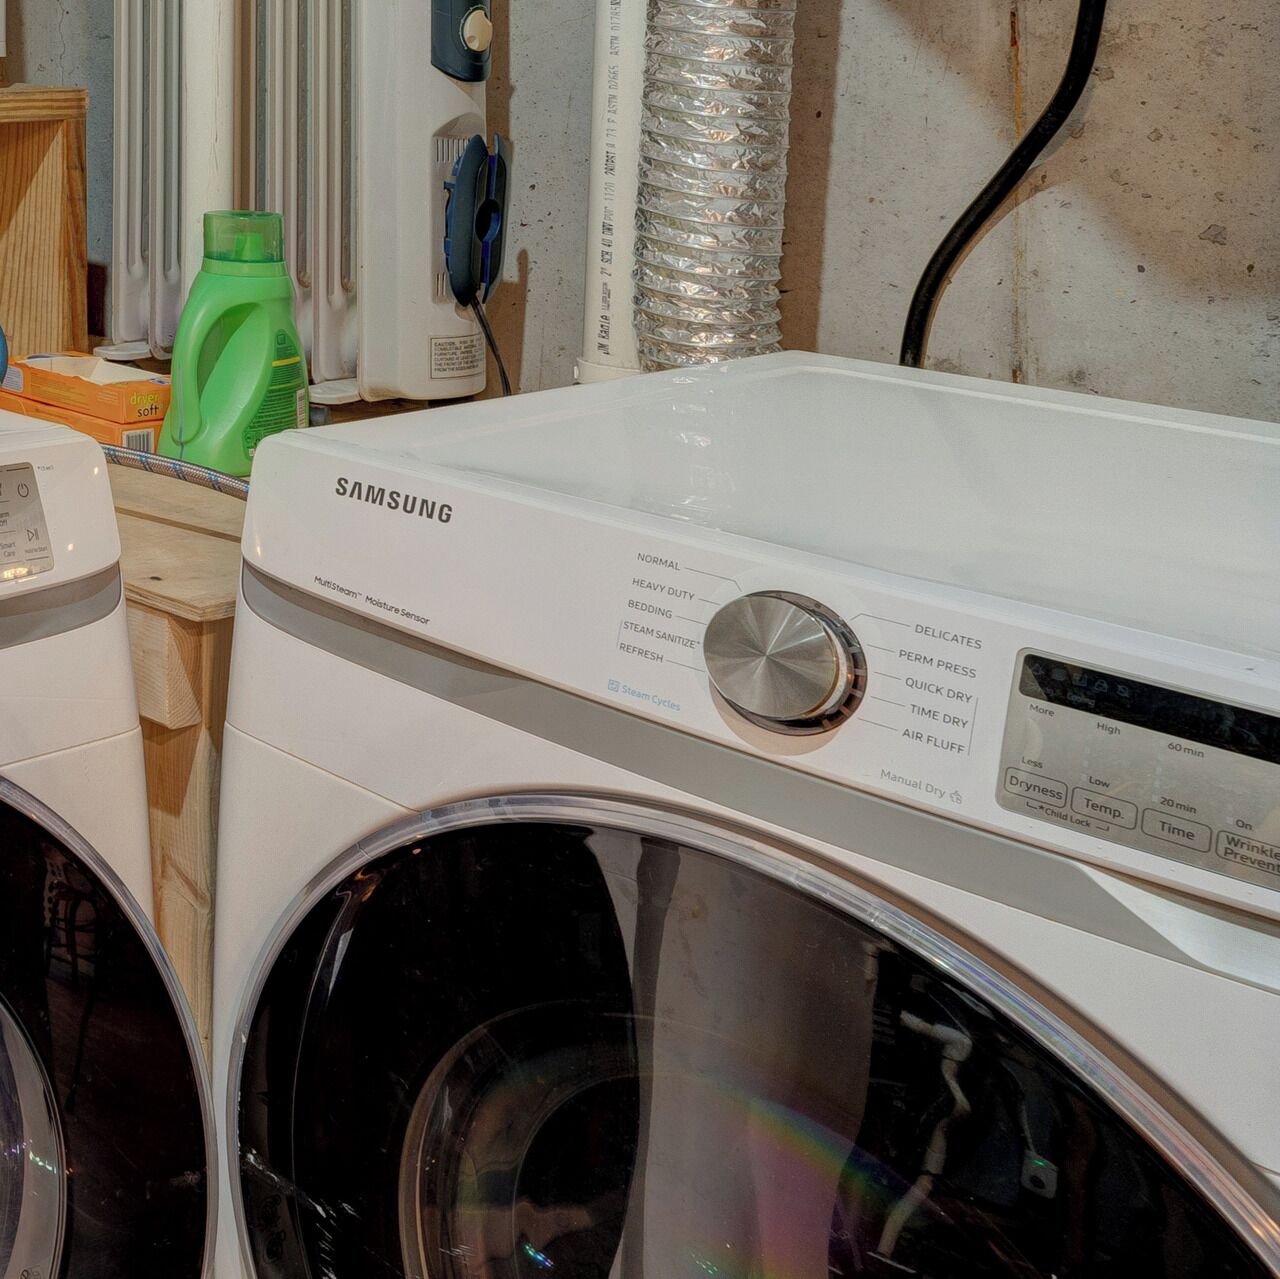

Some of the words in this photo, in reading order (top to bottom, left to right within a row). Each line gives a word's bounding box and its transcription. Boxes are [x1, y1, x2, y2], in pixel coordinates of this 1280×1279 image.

[130, 392, 159, 405] dryer
[138, 404, 159, 417] soft
[335, 477, 453, 524] SAMSUNG
[637, 552, 681, 571] NORMAL
[632, 577, 665, 593] HEAVY
[668, 586, 695, 601] DUTY
[365, 595, 400, 615] Moisture
[401, 608, 430, 624] Sensor
[628, 599, 672, 619] BEDDING
[623, 621, 654, 637] STEAM
[914, 624, 982, 650] DELICATES
[619, 642, 664, 663] REFRESH
[898, 649, 934, 666] PERM
[936, 659, 977, 679] PRESS
[622, 684, 650, 701] Steam
[652, 695, 681, 712] Cycles
[905, 677, 944, 696] QUICK
[947, 688, 973, 704] DRY
[910, 704, 940, 720] TIME
[942, 714, 968, 729] DRY
[1029, 703, 1055, 718] More
[1096, 722, 1121, 735] High
[902, 728, 923, 742] AIR
[926, 735, 965, 754] FLUFF
[1168, 742, 1182, 752] 60
[1183, 746, 1204, 758] min
[1022, 756, 1043, 769] Less
[880, 769, 922, 790] Manual
[925, 783, 945, 798] Dry
[1010, 775, 1063, 801] Dryness
[1089, 776, 1110, 789] Low
[1084, 798, 1124, 820] Temp.
[1160, 797, 1174, 808] 20
[1176, 803, 1197, 814] min
[1071, 815, 1090, 828] Lock
[1160, 821, 1195, 841] Time
[1236, 820, 1252, 830] On
[1226, 834, 1280, 860] Wrinkle
